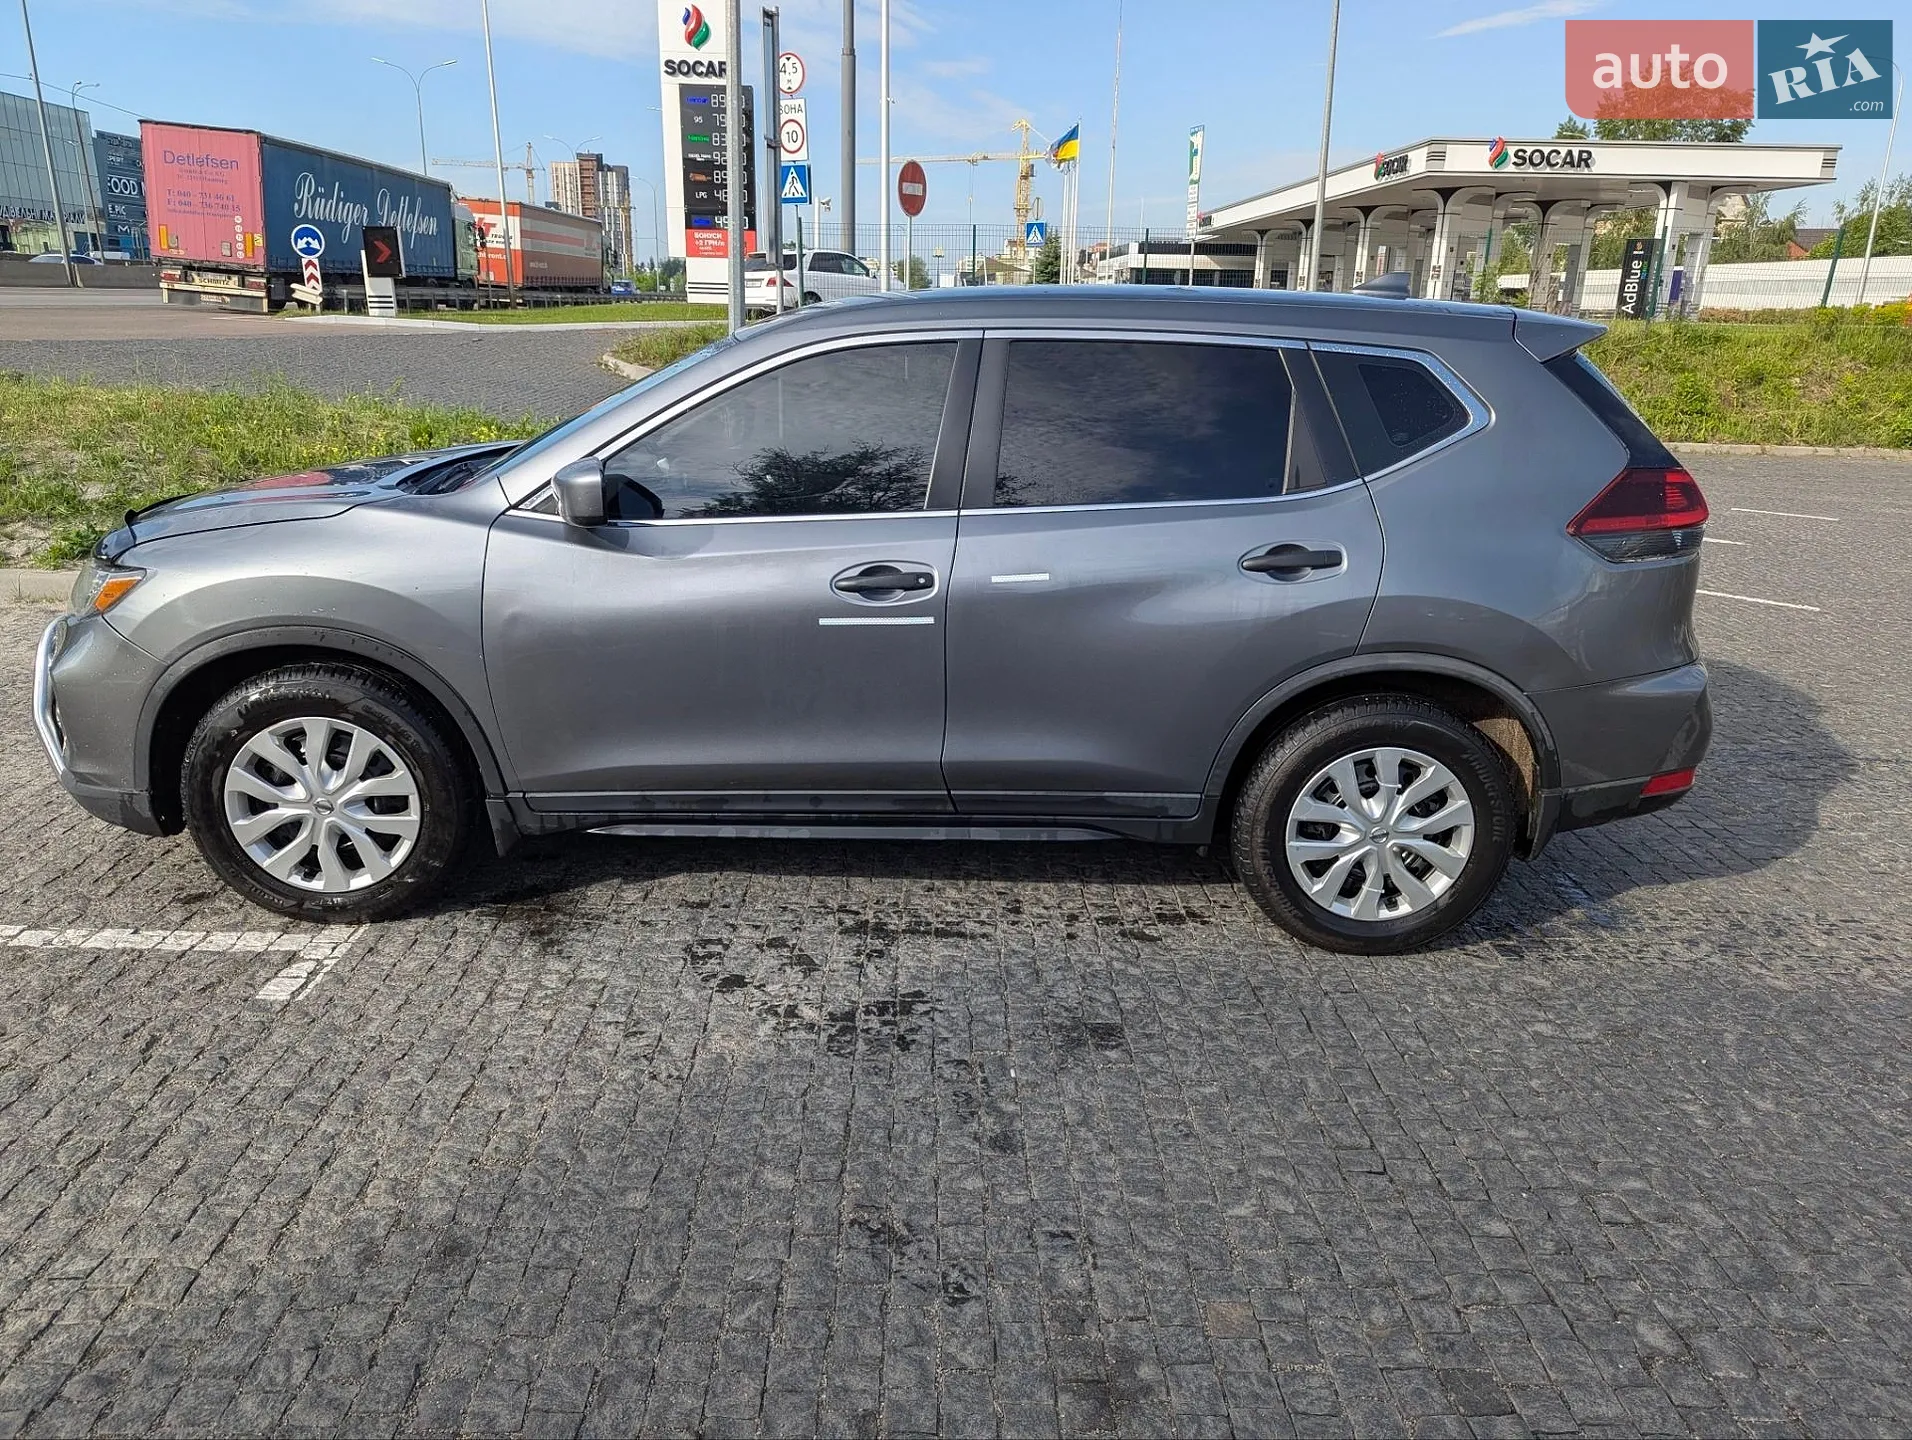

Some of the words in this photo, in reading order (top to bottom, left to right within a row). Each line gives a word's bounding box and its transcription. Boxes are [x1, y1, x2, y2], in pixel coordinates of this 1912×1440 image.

[693, 116, 703, 124] 95
[785, 130, 798, 143] 10
[163, 150, 239, 171] Detlefsen
[1382, 154, 1409, 178] SOCAR
[1512, 148, 1594, 169] SOCAR
[696, 191, 708, 199] LPG
[294, 172, 369, 244] Rüdiger
[377, 188, 438, 249] Detlefsen
[1621, 260, 1642, 315] AdBlue
